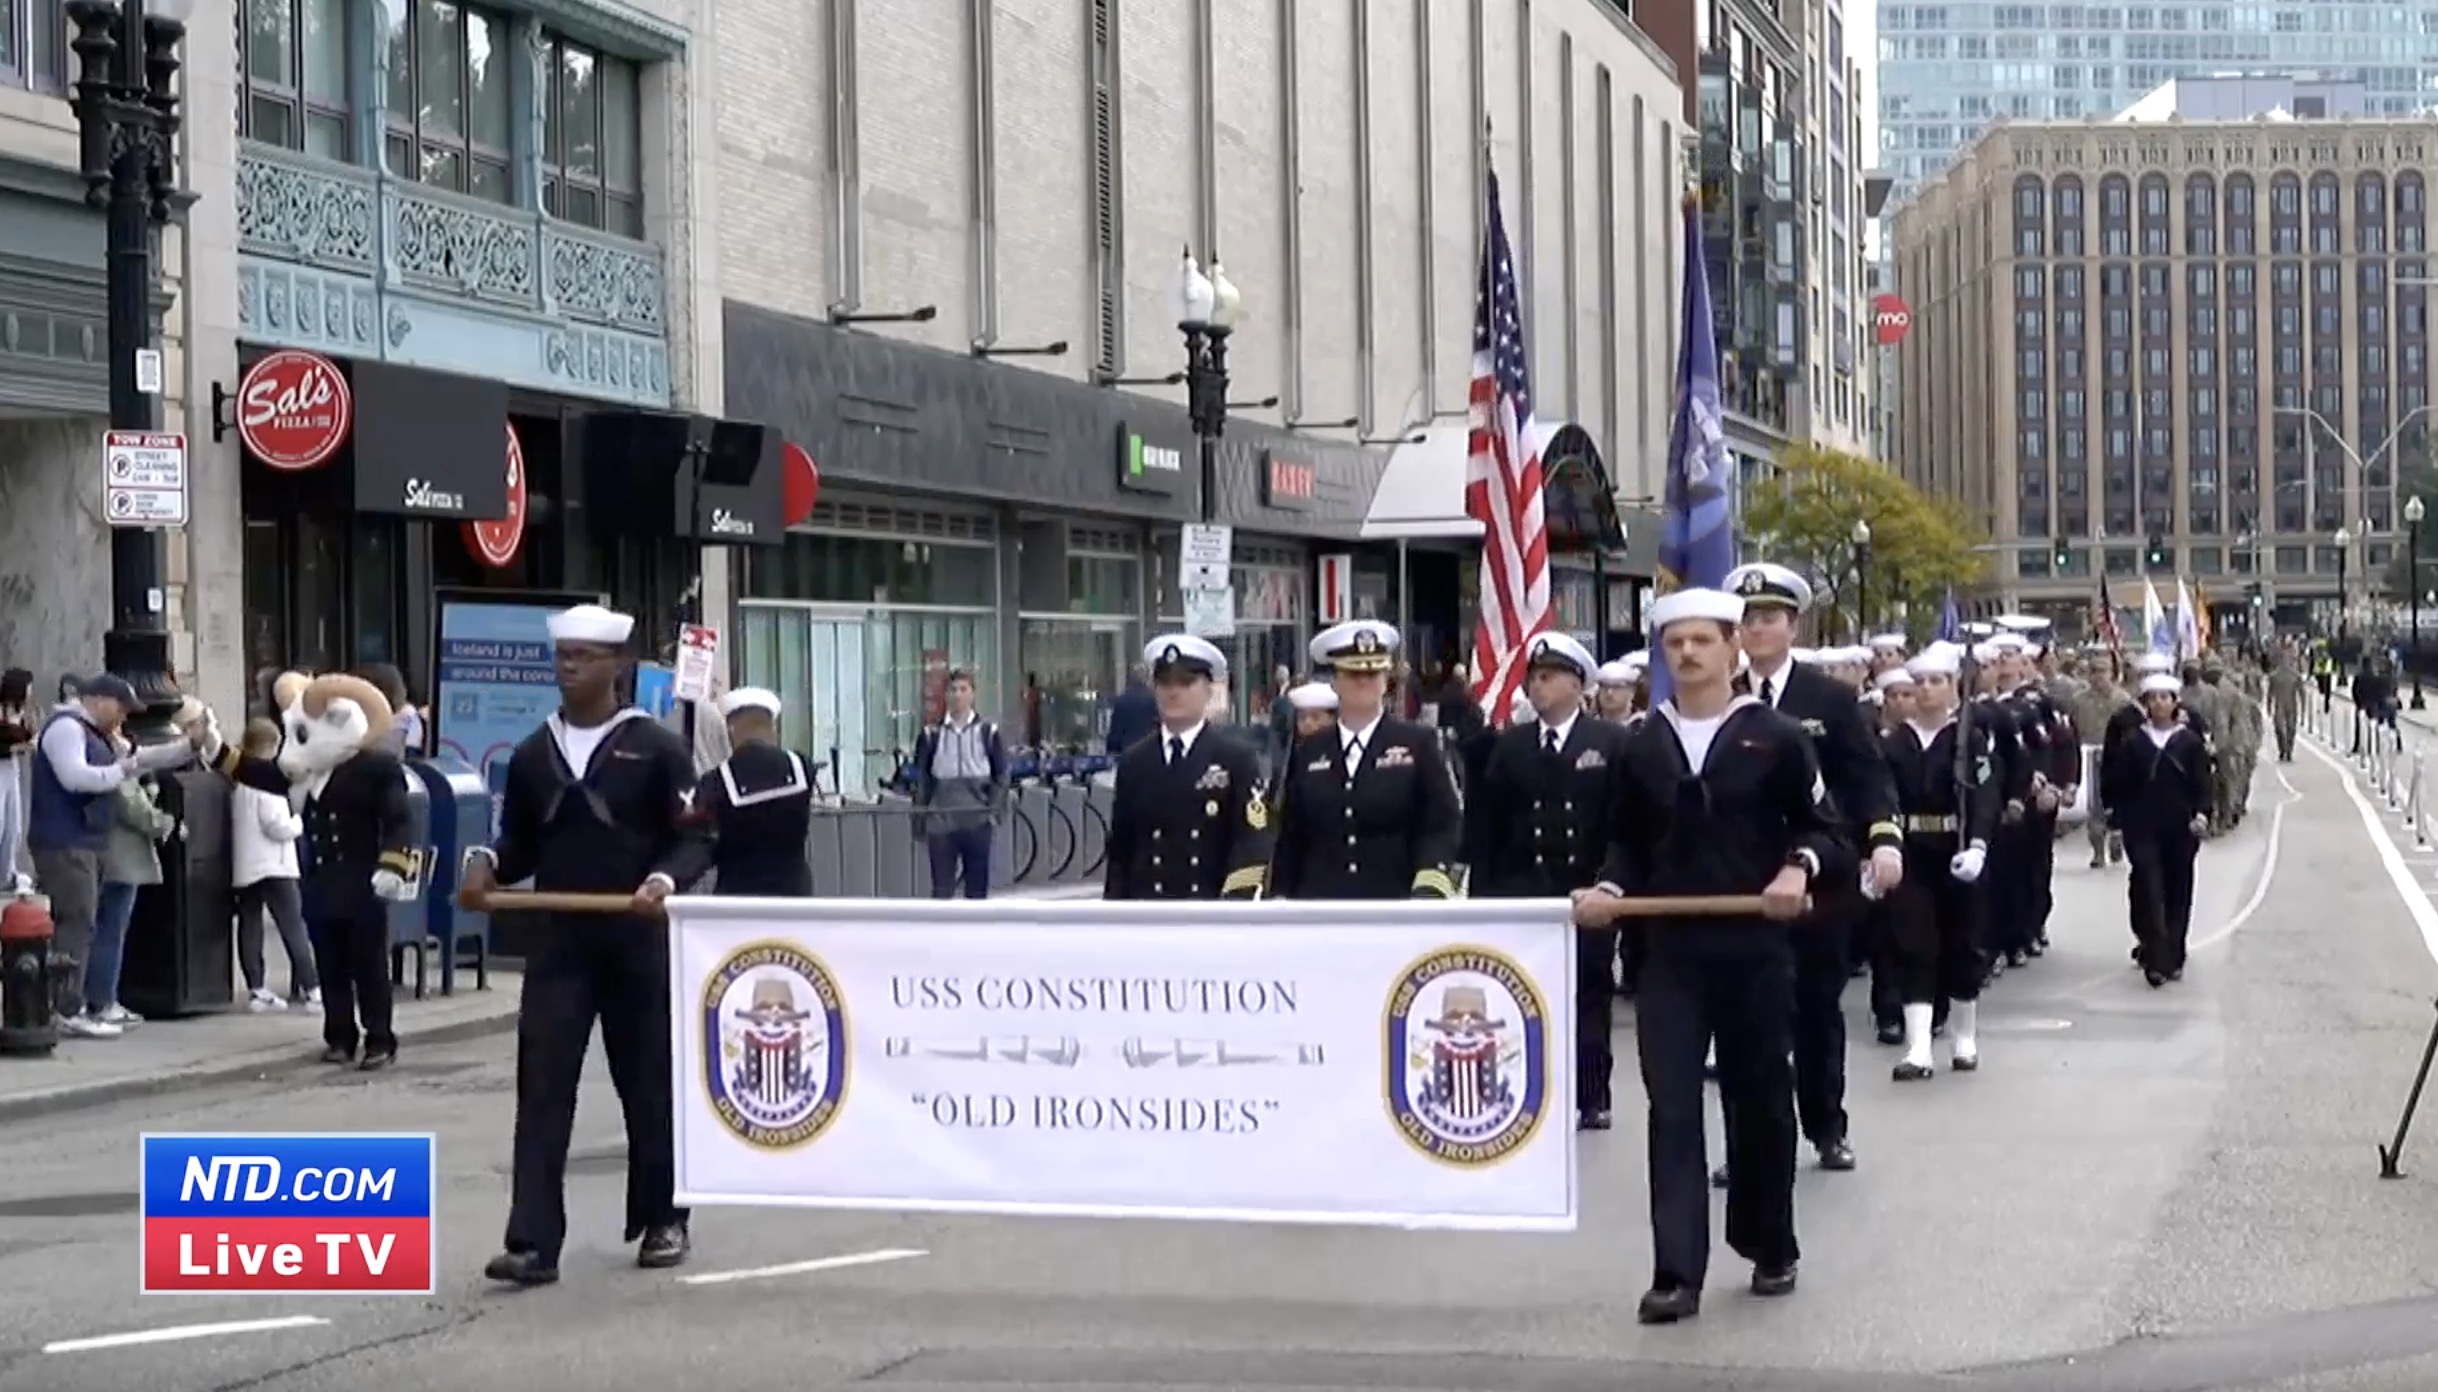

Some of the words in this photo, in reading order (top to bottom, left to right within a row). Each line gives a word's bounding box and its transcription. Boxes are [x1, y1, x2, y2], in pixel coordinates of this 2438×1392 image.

[245, 366, 332, 426] Sal's
[113, 435, 140, 446] TOW
[144, 436, 178, 447] ZONE
[273, 416, 309, 429] PIZZA
[452, 643, 499, 657] Iceland
[502, 644, 513, 657] is
[514, 645, 540, 660] just
[451, 667, 497, 682] around
[499, 668, 521, 682] the
[729, 949, 838, 1010] CONSTITUTION
[892, 975, 962, 1010] USS
[976, 976, 1298, 1013] CONSTITUTION
[1415, 955, 1538, 1019] CONSTITUTION
[717, 1096, 746, 1133] OLD
[748, 1100, 833, 1146] IRONSIDES
[912, 1092, 1015, 1128] “OLD
[1034, 1095, 1280, 1133] IRONSIDES”
[1400, 1111, 1434, 1148] OLD
[1437, 1112, 1535, 1161] IRONSIDES
